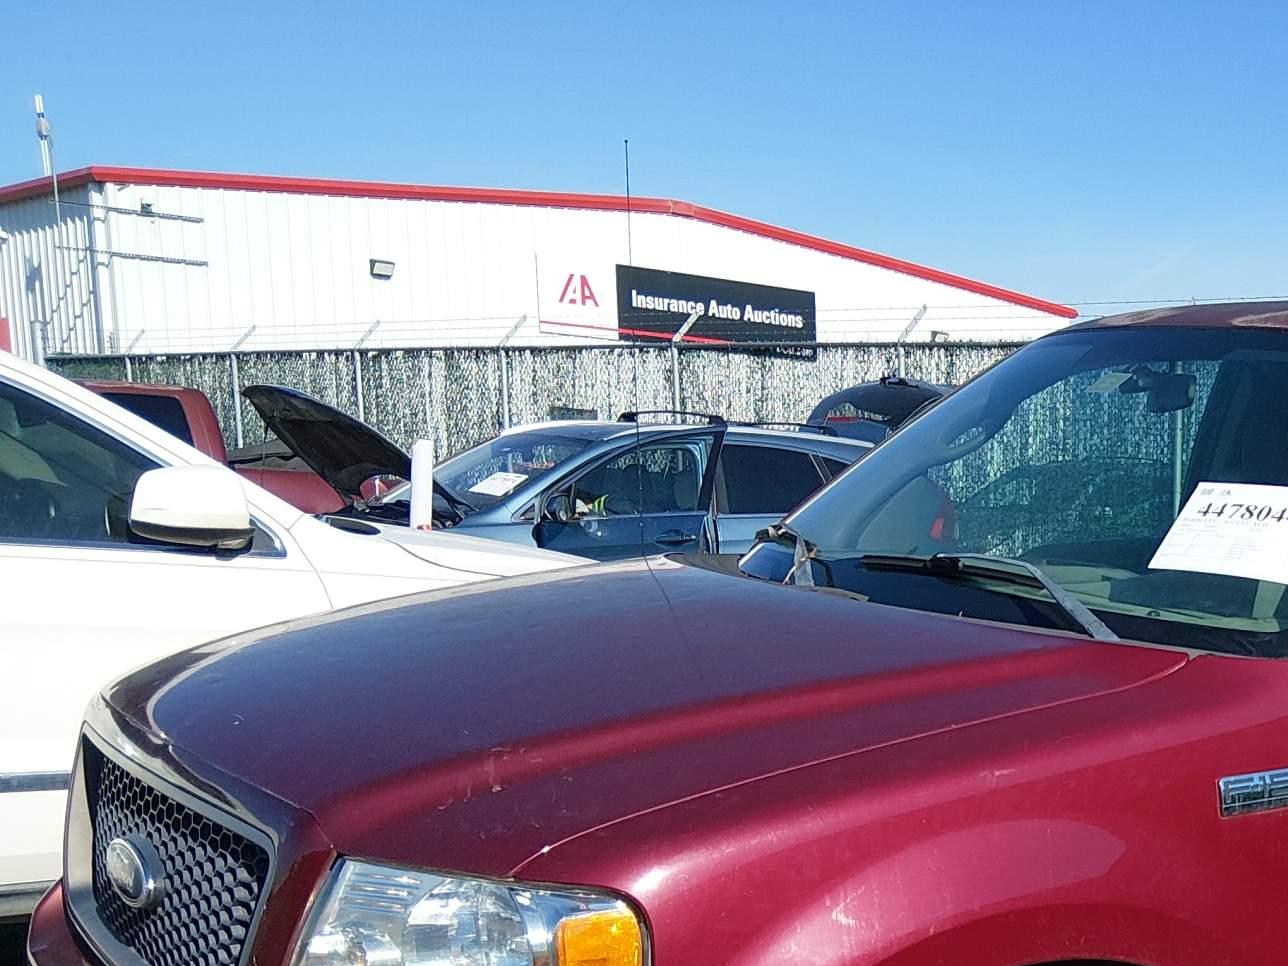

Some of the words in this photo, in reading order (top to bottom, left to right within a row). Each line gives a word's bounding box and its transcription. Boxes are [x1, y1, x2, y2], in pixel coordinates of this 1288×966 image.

[631, 289, 705, 316] Insurance
[707, 299, 741, 321] Auto
[743, 304, 804, 328] Auctions
